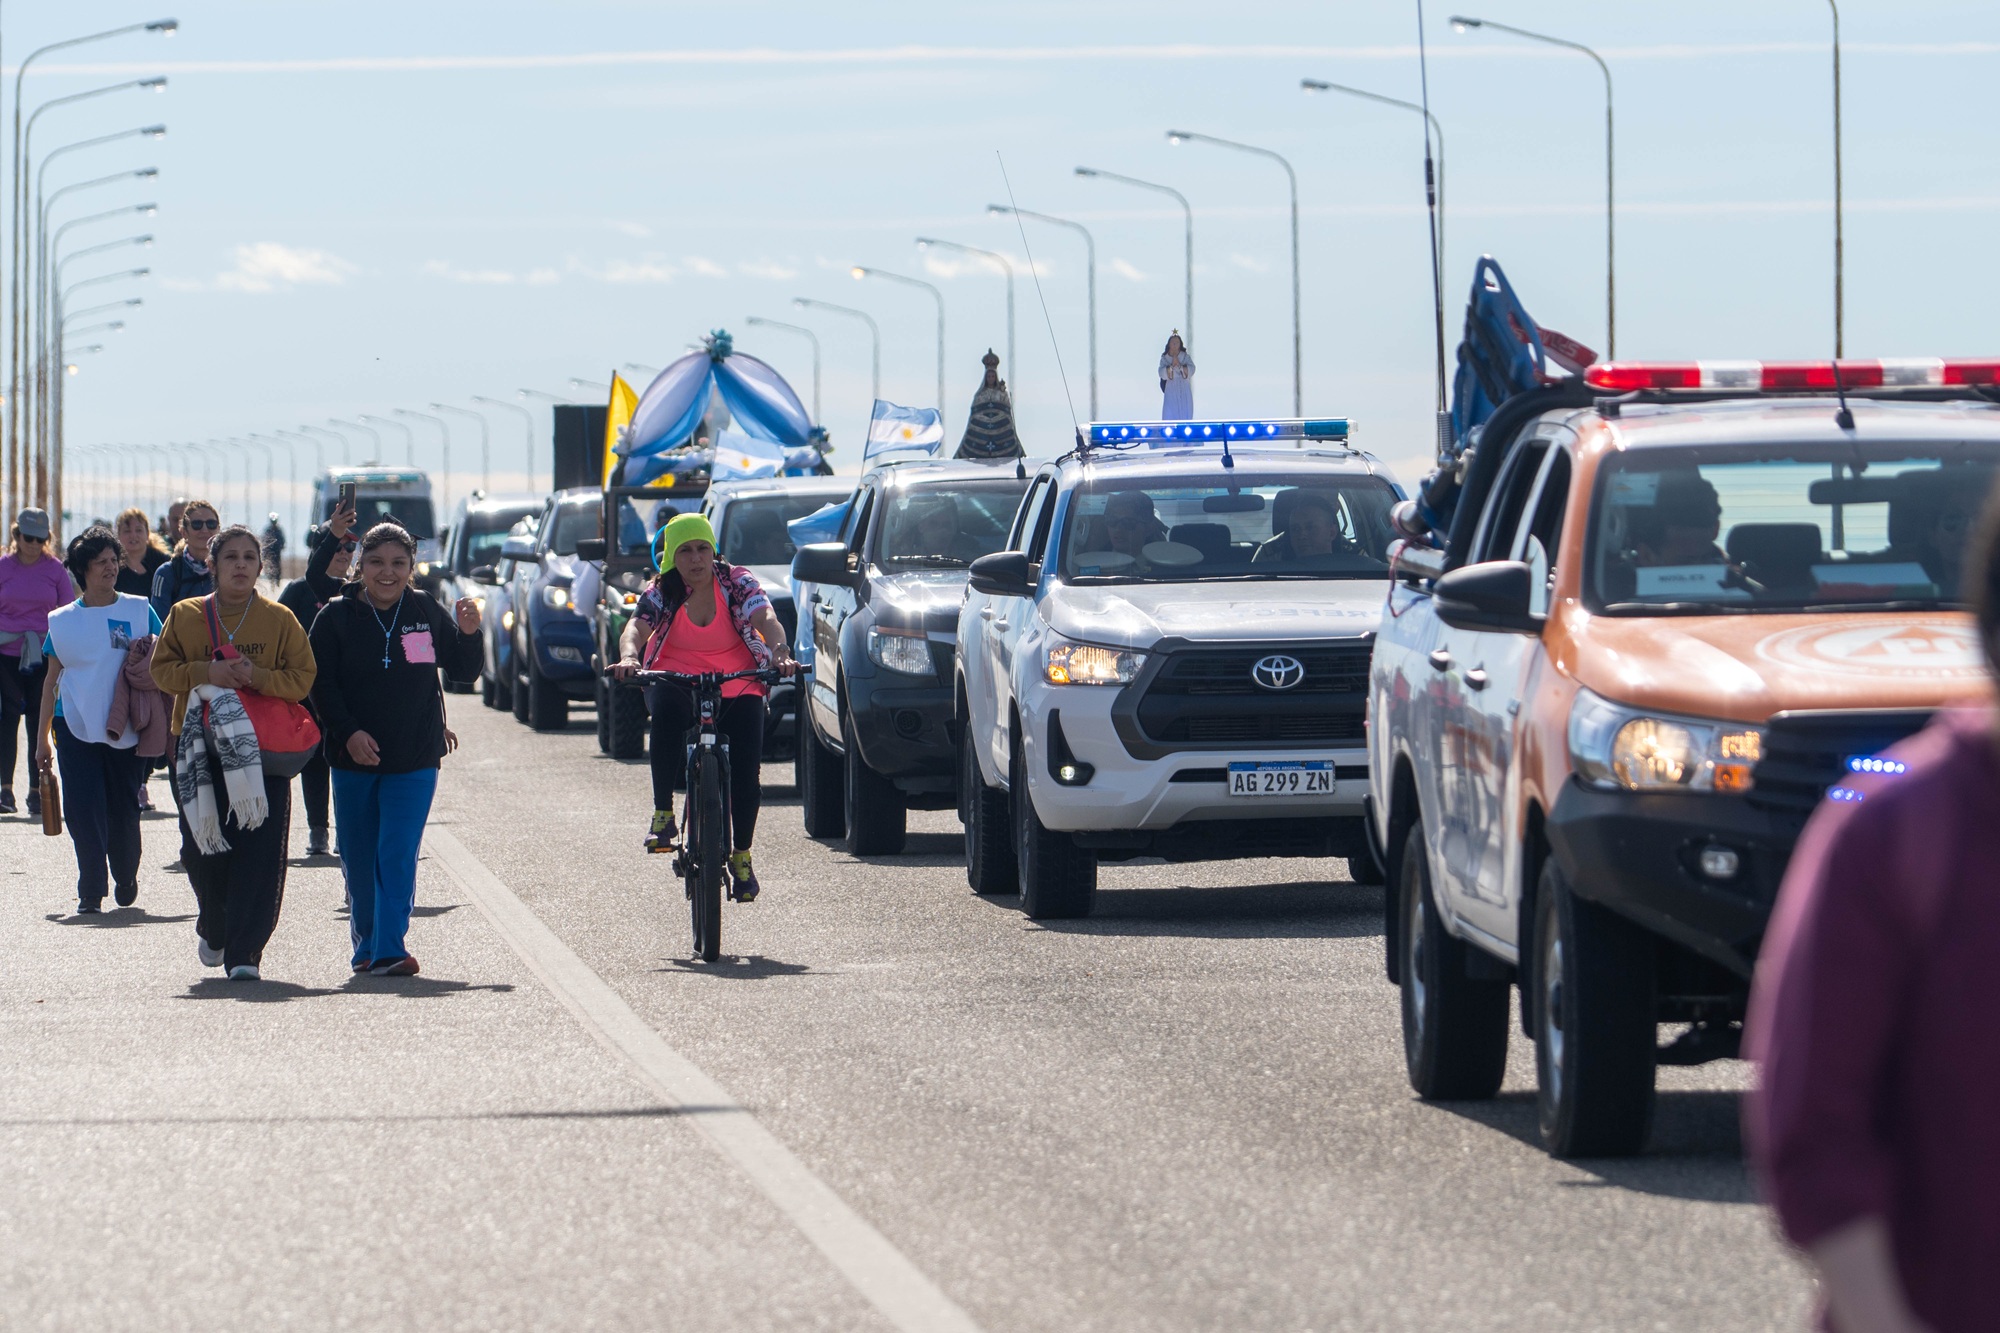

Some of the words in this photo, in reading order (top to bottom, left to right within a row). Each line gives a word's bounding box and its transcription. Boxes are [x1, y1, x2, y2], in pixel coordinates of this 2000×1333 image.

[204, 642, 267, 657] LDARY
[1234, 773, 1258, 792] AG
[1264, 772, 1299, 792] 299
[1305, 771, 1330, 792] ZN
